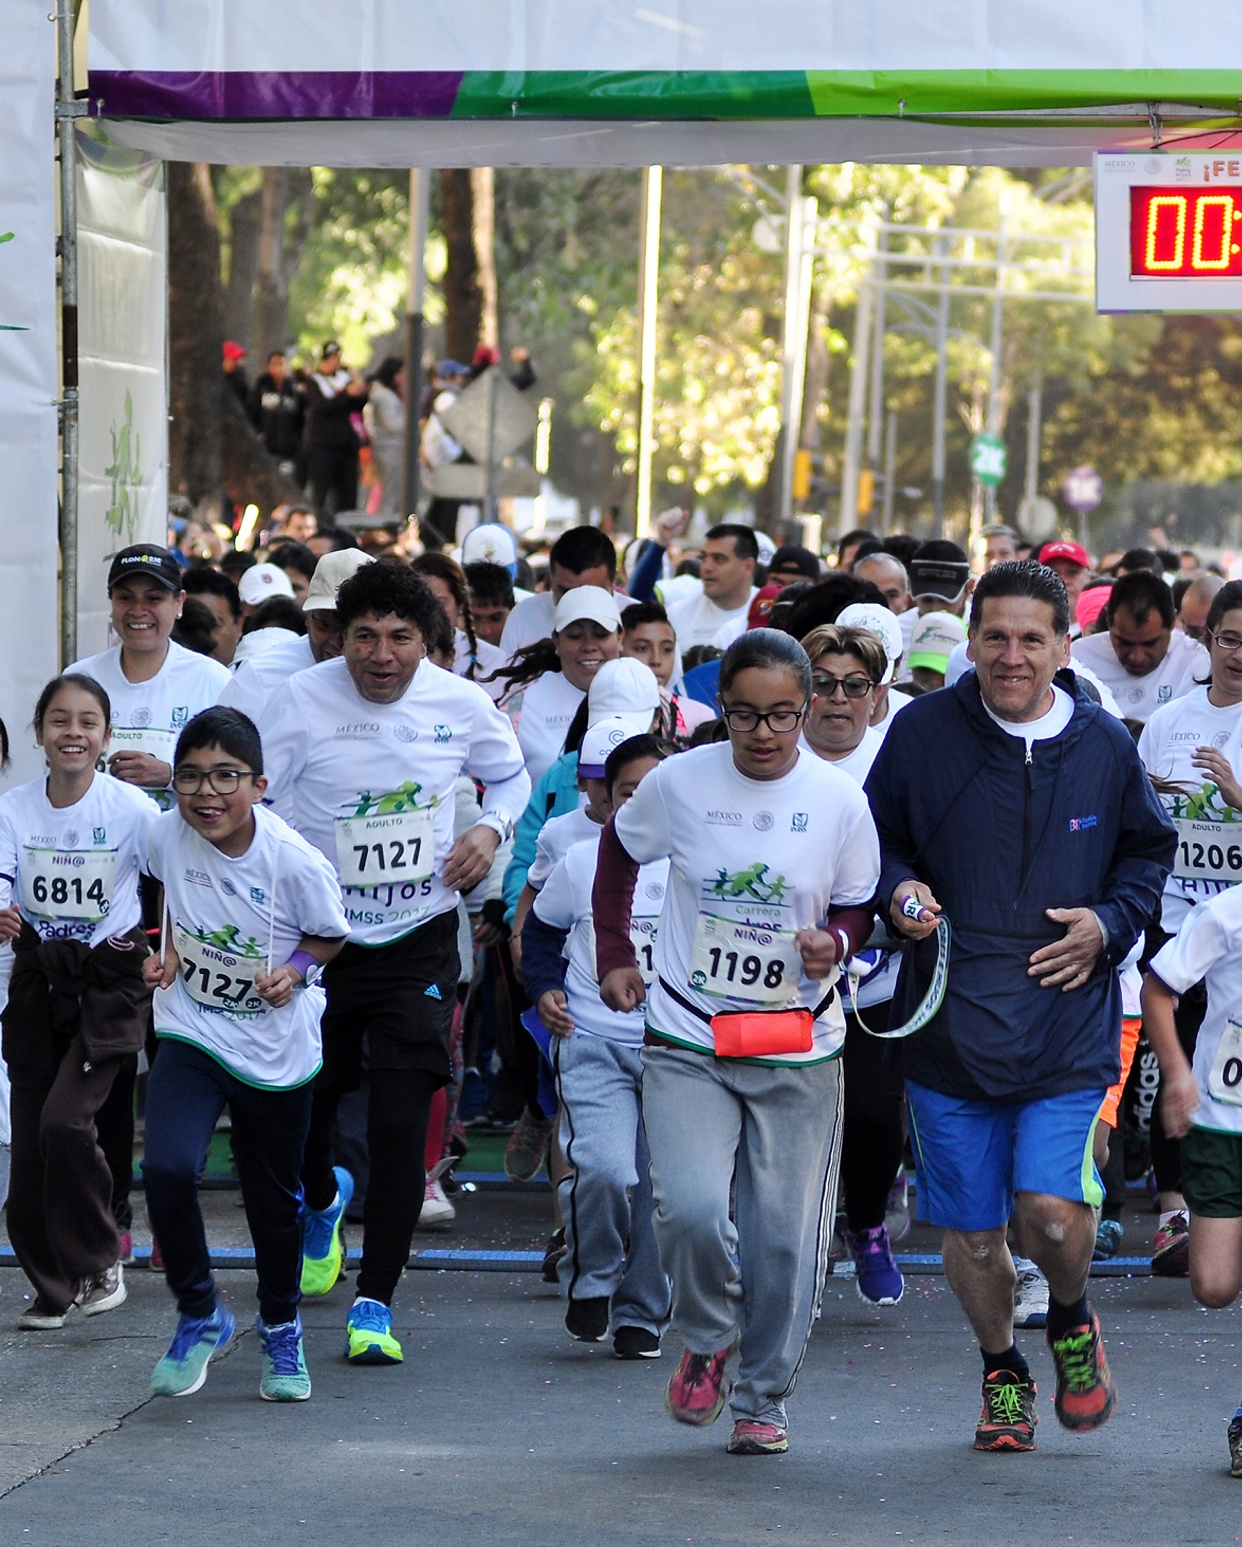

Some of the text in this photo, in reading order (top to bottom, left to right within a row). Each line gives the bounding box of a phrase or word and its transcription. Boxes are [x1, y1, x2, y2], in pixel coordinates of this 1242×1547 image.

[1105, 159, 1136, 167] MÉXICO
[336, 722, 379, 735] MÉXICO
[706, 809, 742, 821] MÉXICO
[366, 817, 403, 830] ADULTO
[1192, 823, 1221, 832] ADULTO
[52, 854, 85, 868] NIÑ@
[353, 837, 422, 872] 7127
[1181, 841, 1242, 870] 1206
[33, 875, 104, 905] 6814
[736, 904, 781, 919] Carrera
[734, 926, 772, 945] NIÑ@
[201, 946, 236, 967] NIÑ@
[709, 947, 785, 990] 1198
[182, 957, 253, 1001] 7127
[247, 999, 260, 1008] 2K
